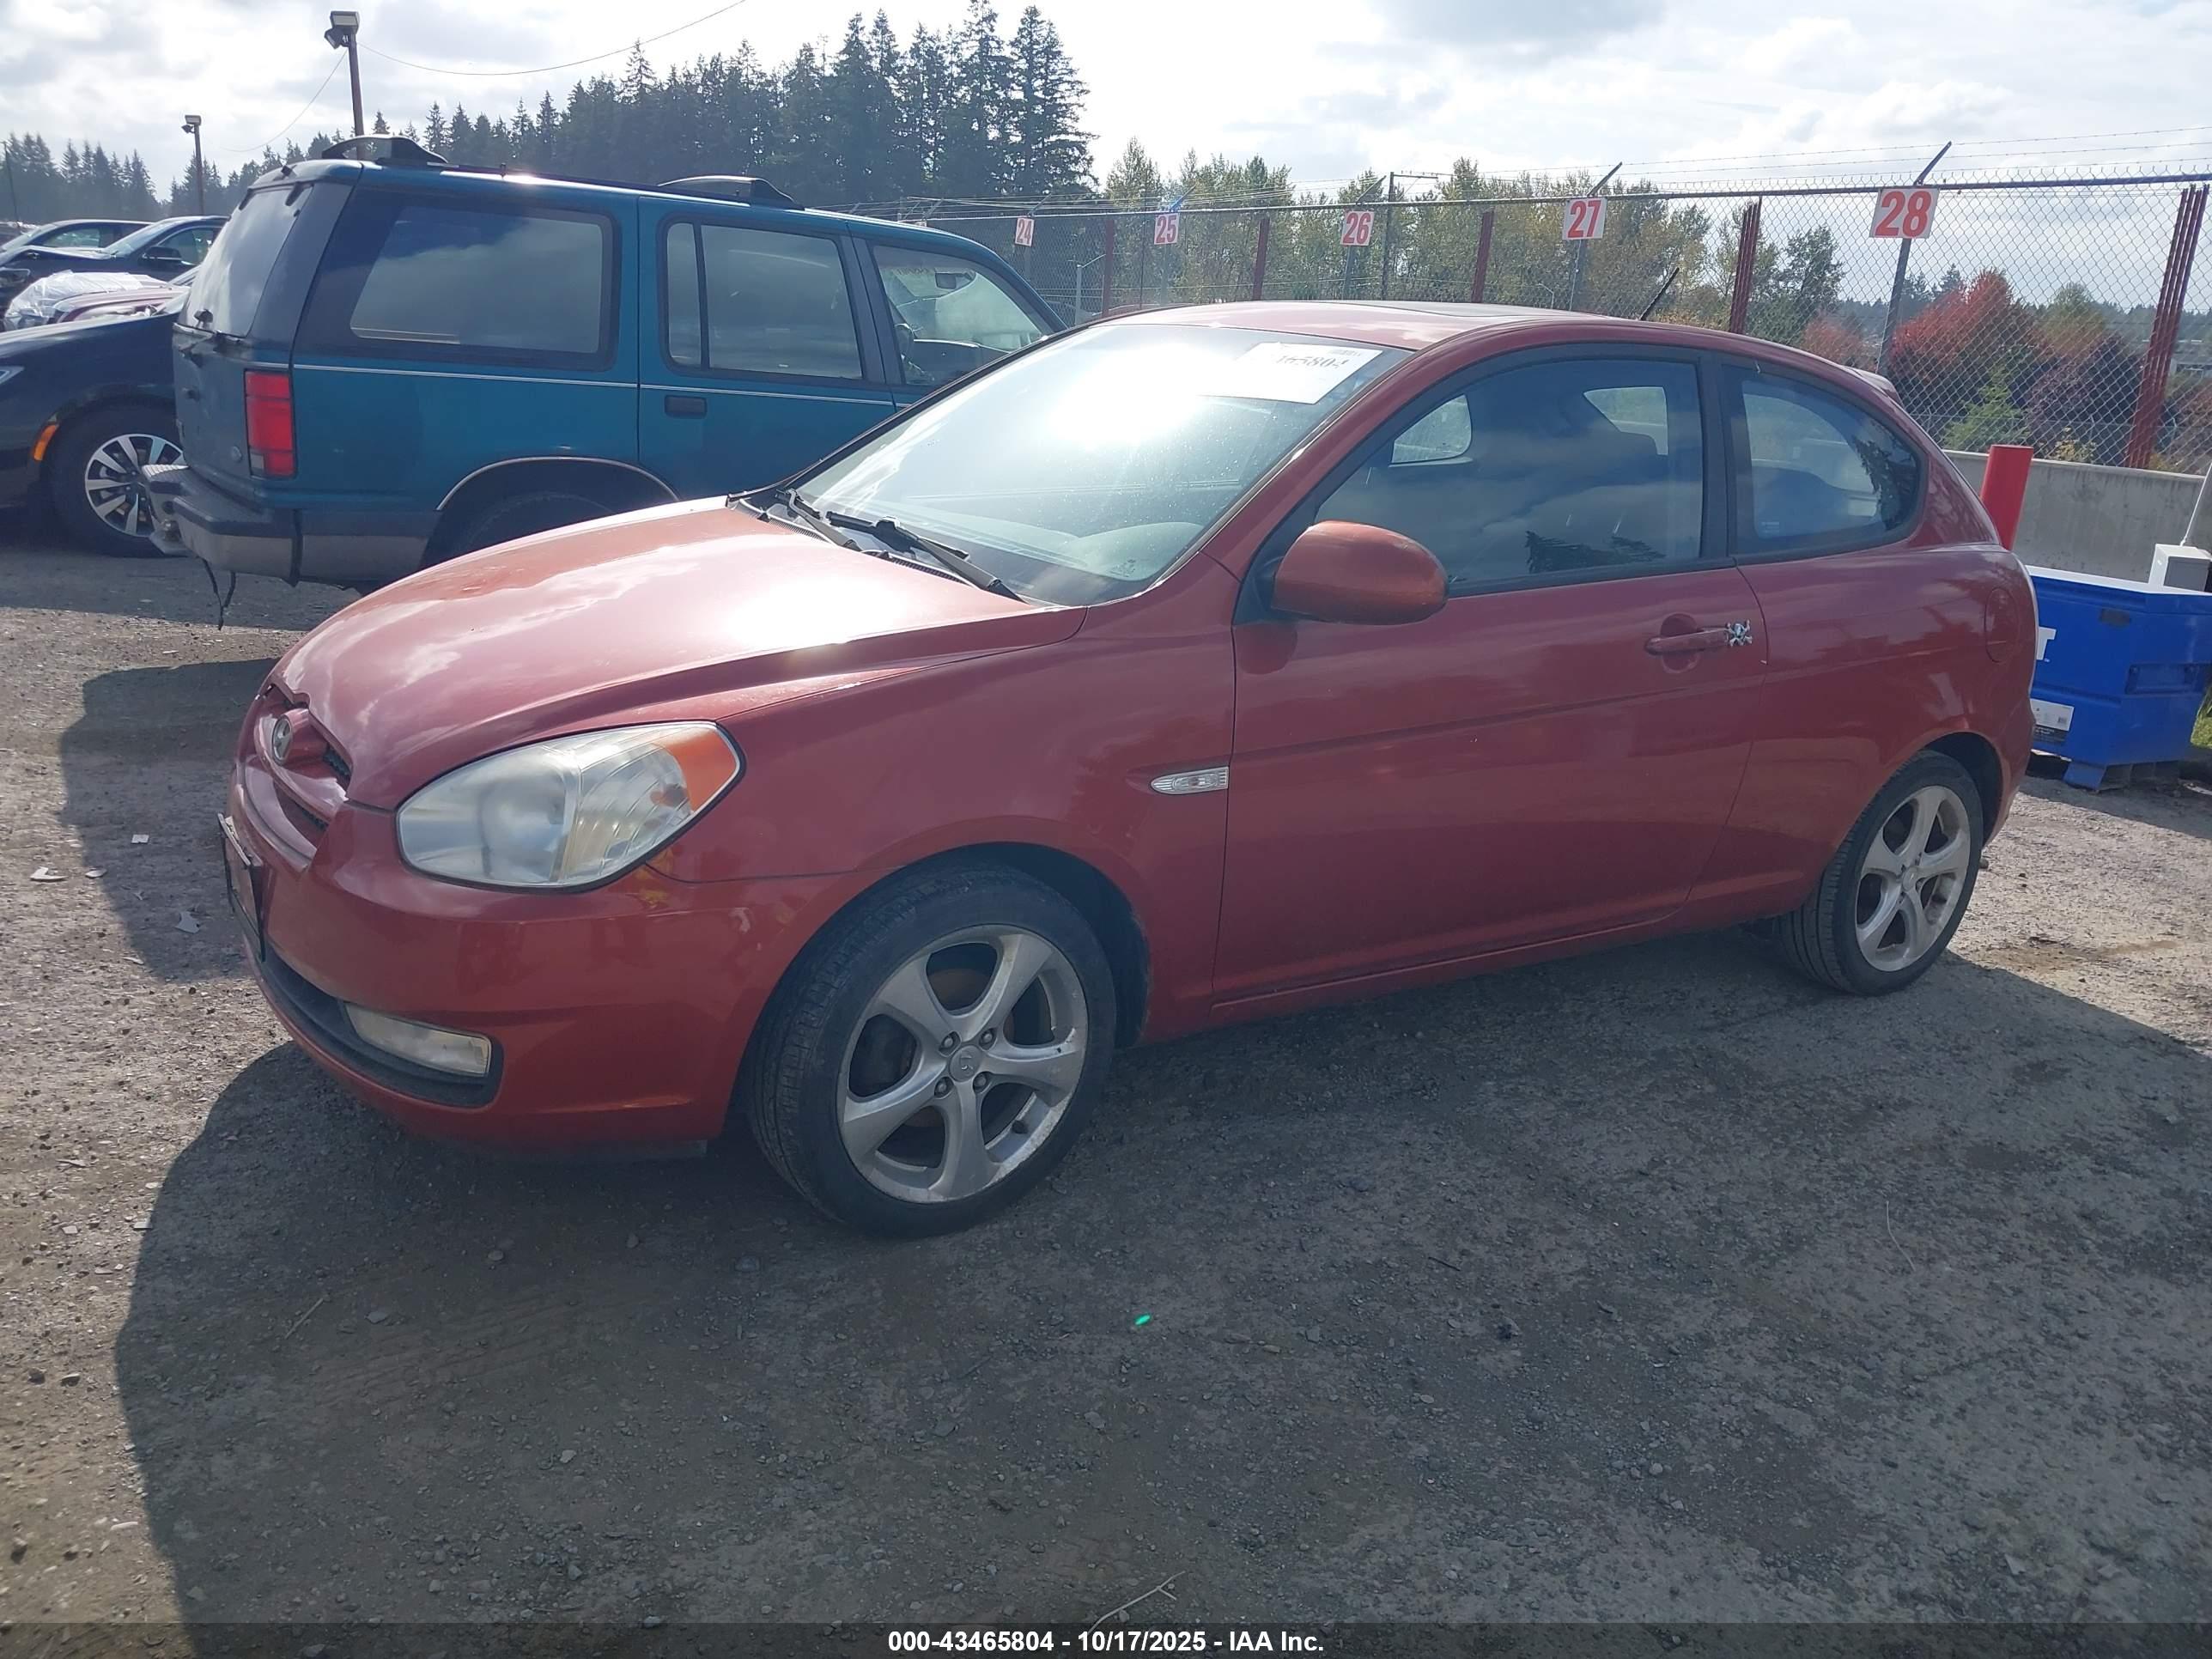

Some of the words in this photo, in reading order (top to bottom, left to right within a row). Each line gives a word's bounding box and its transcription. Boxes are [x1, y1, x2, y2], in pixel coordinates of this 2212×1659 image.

[1155, 215, 1177, 243] 25
[1342, 212, 1371, 244] 26
[1567, 199, 1601, 238] 27
[1875, 190, 1932, 238] 28
[1016, 219, 1032, 245] 24
